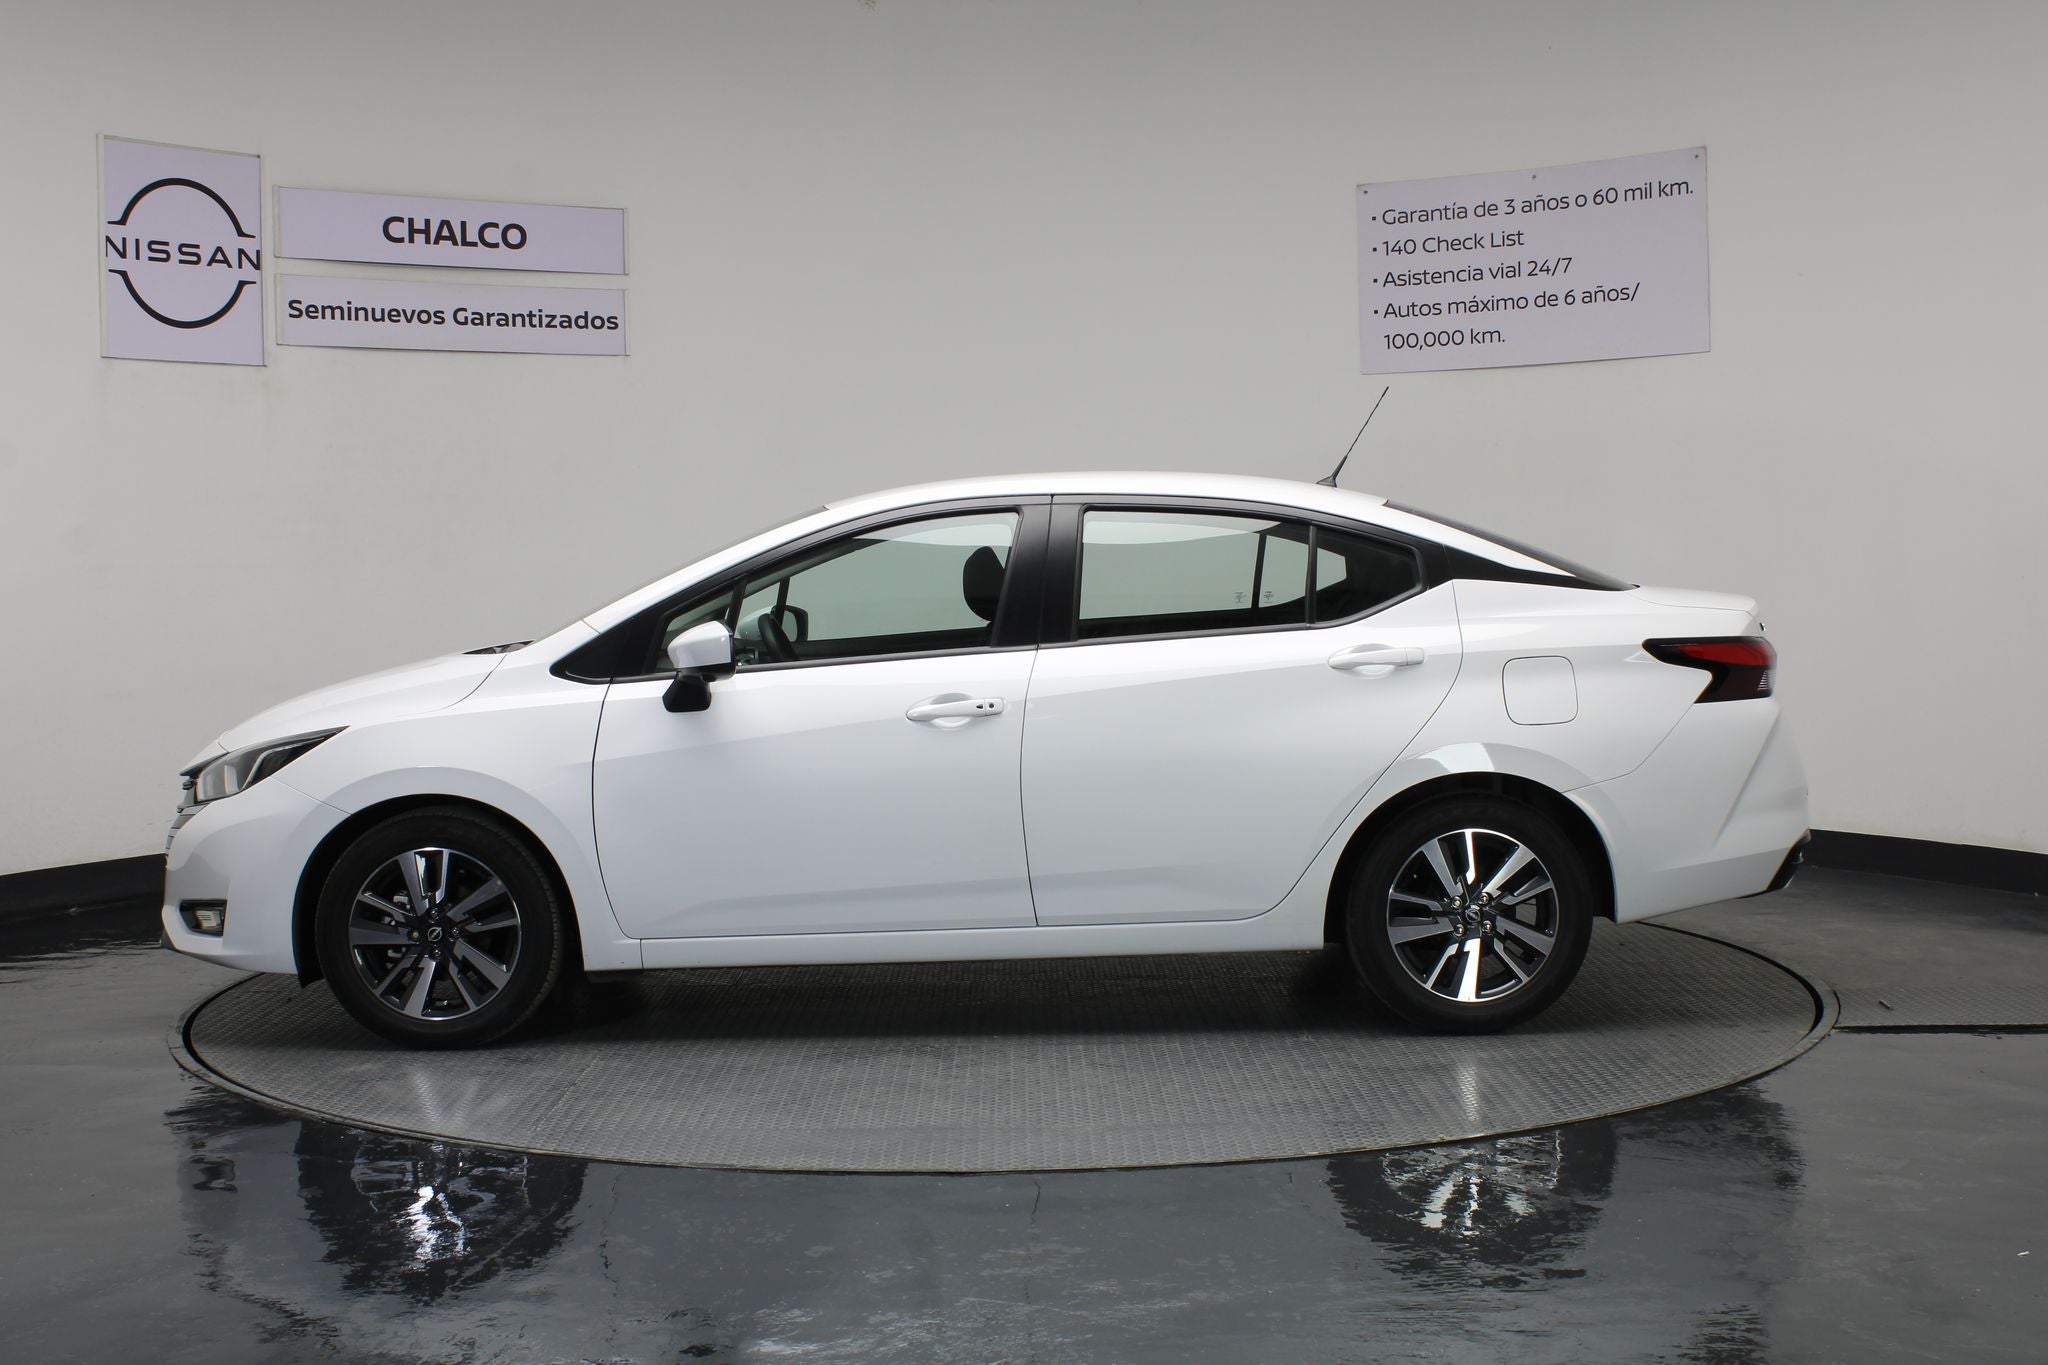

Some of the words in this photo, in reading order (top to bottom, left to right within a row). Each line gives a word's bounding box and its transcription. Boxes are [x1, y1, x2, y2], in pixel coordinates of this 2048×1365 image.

[1381, 201, 1468, 226] Garantía
[1473, 200, 1499, 218] de
[1503, 198, 1516, 216] 3
[1520, 194, 1570, 214] años
[1574, 193, 1588, 208] o
[1592, 187, 1619, 206] 60
[1623, 181, 1653, 202] mil
[1658, 179, 1695, 198] km.
[382, 215, 528, 251] CHALCO
[1381, 238, 1417, 257] 140
[1422, 232, 1486, 254] Check
[1490, 230, 1525, 248] List
[105, 235, 261, 271] NISSAN
[1382, 265, 1484, 288] Asistencia
[1488, 260, 1521, 280] vial
[1527, 256, 1573, 278] 24/7
[287, 299, 446, 326] Seminuevos
[452, 307, 620, 331] Garantizados
[1383, 301, 1443, 319] Autos
[1447, 295, 1529, 315] máximo
[1533, 290, 1559, 309] de
[1563, 288, 1576, 306] 6
[1581, 281, 1641, 305] años/
[1383, 329, 1465, 351] 100,000
[1470, 327, 1506, 345] km.
